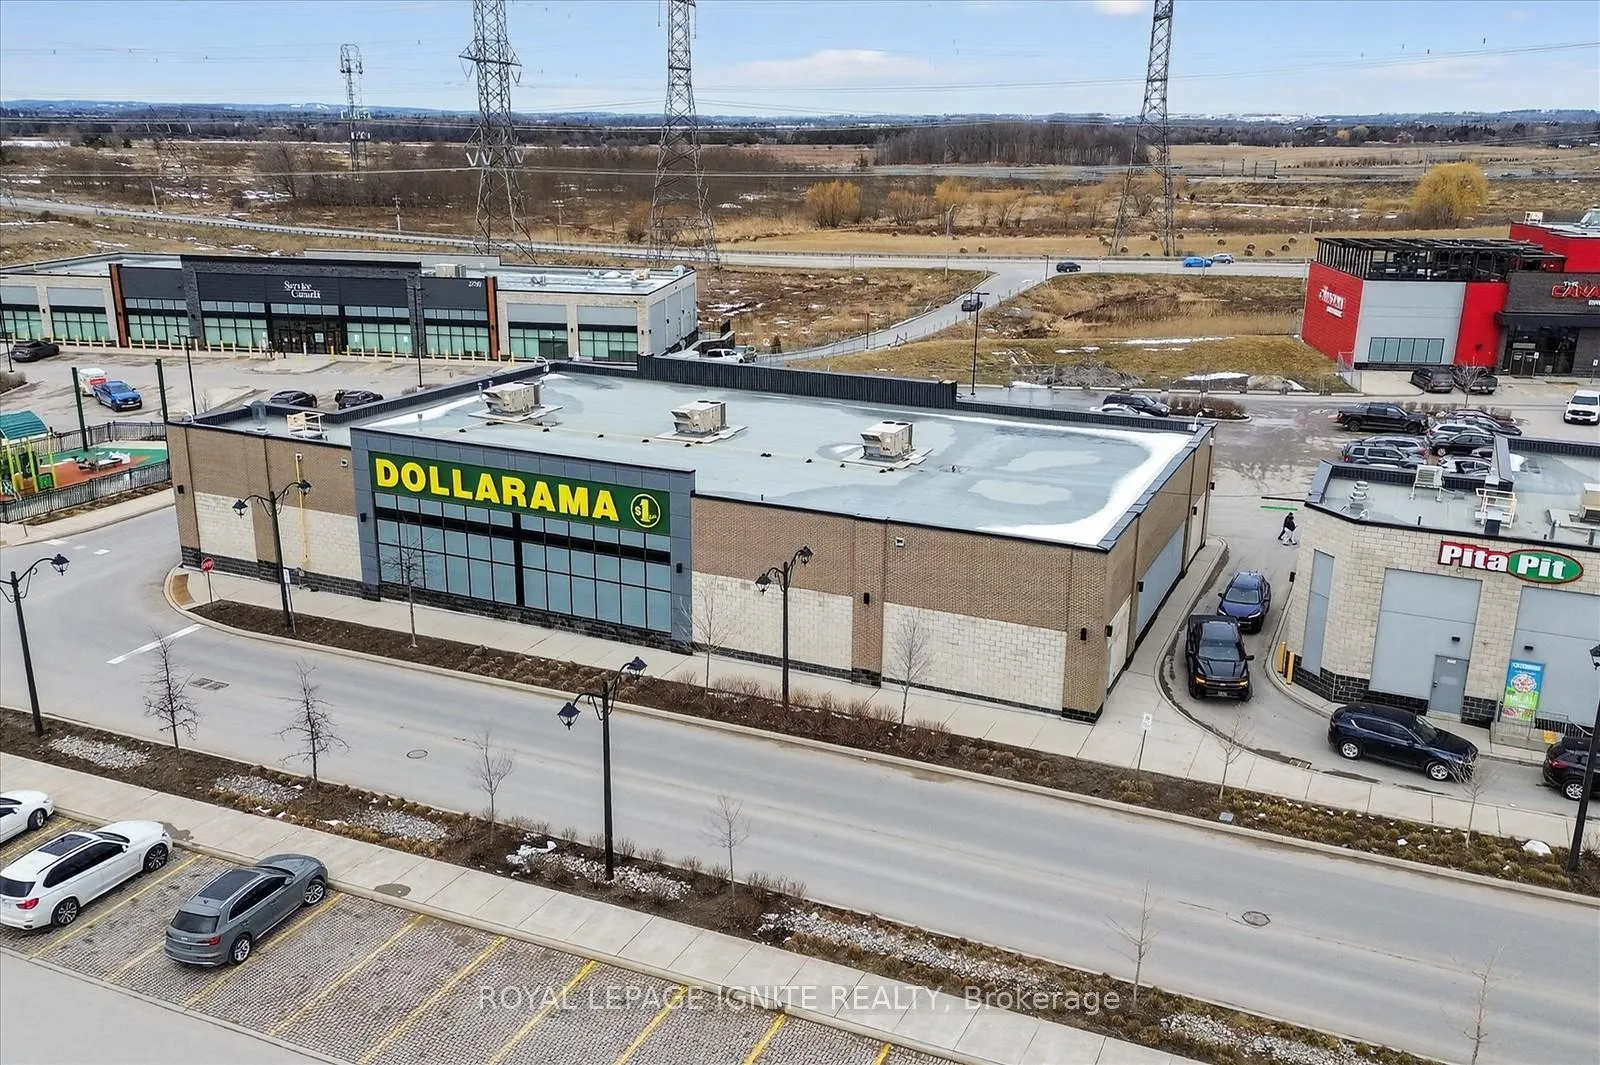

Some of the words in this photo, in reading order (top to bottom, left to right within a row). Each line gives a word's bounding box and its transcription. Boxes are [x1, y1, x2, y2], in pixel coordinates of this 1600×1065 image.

[374, 457, 620, 523] DOLLARAMA
[1439, 543, 1508, 573] Pita
[1517, 553, 1567, 580] Pit
